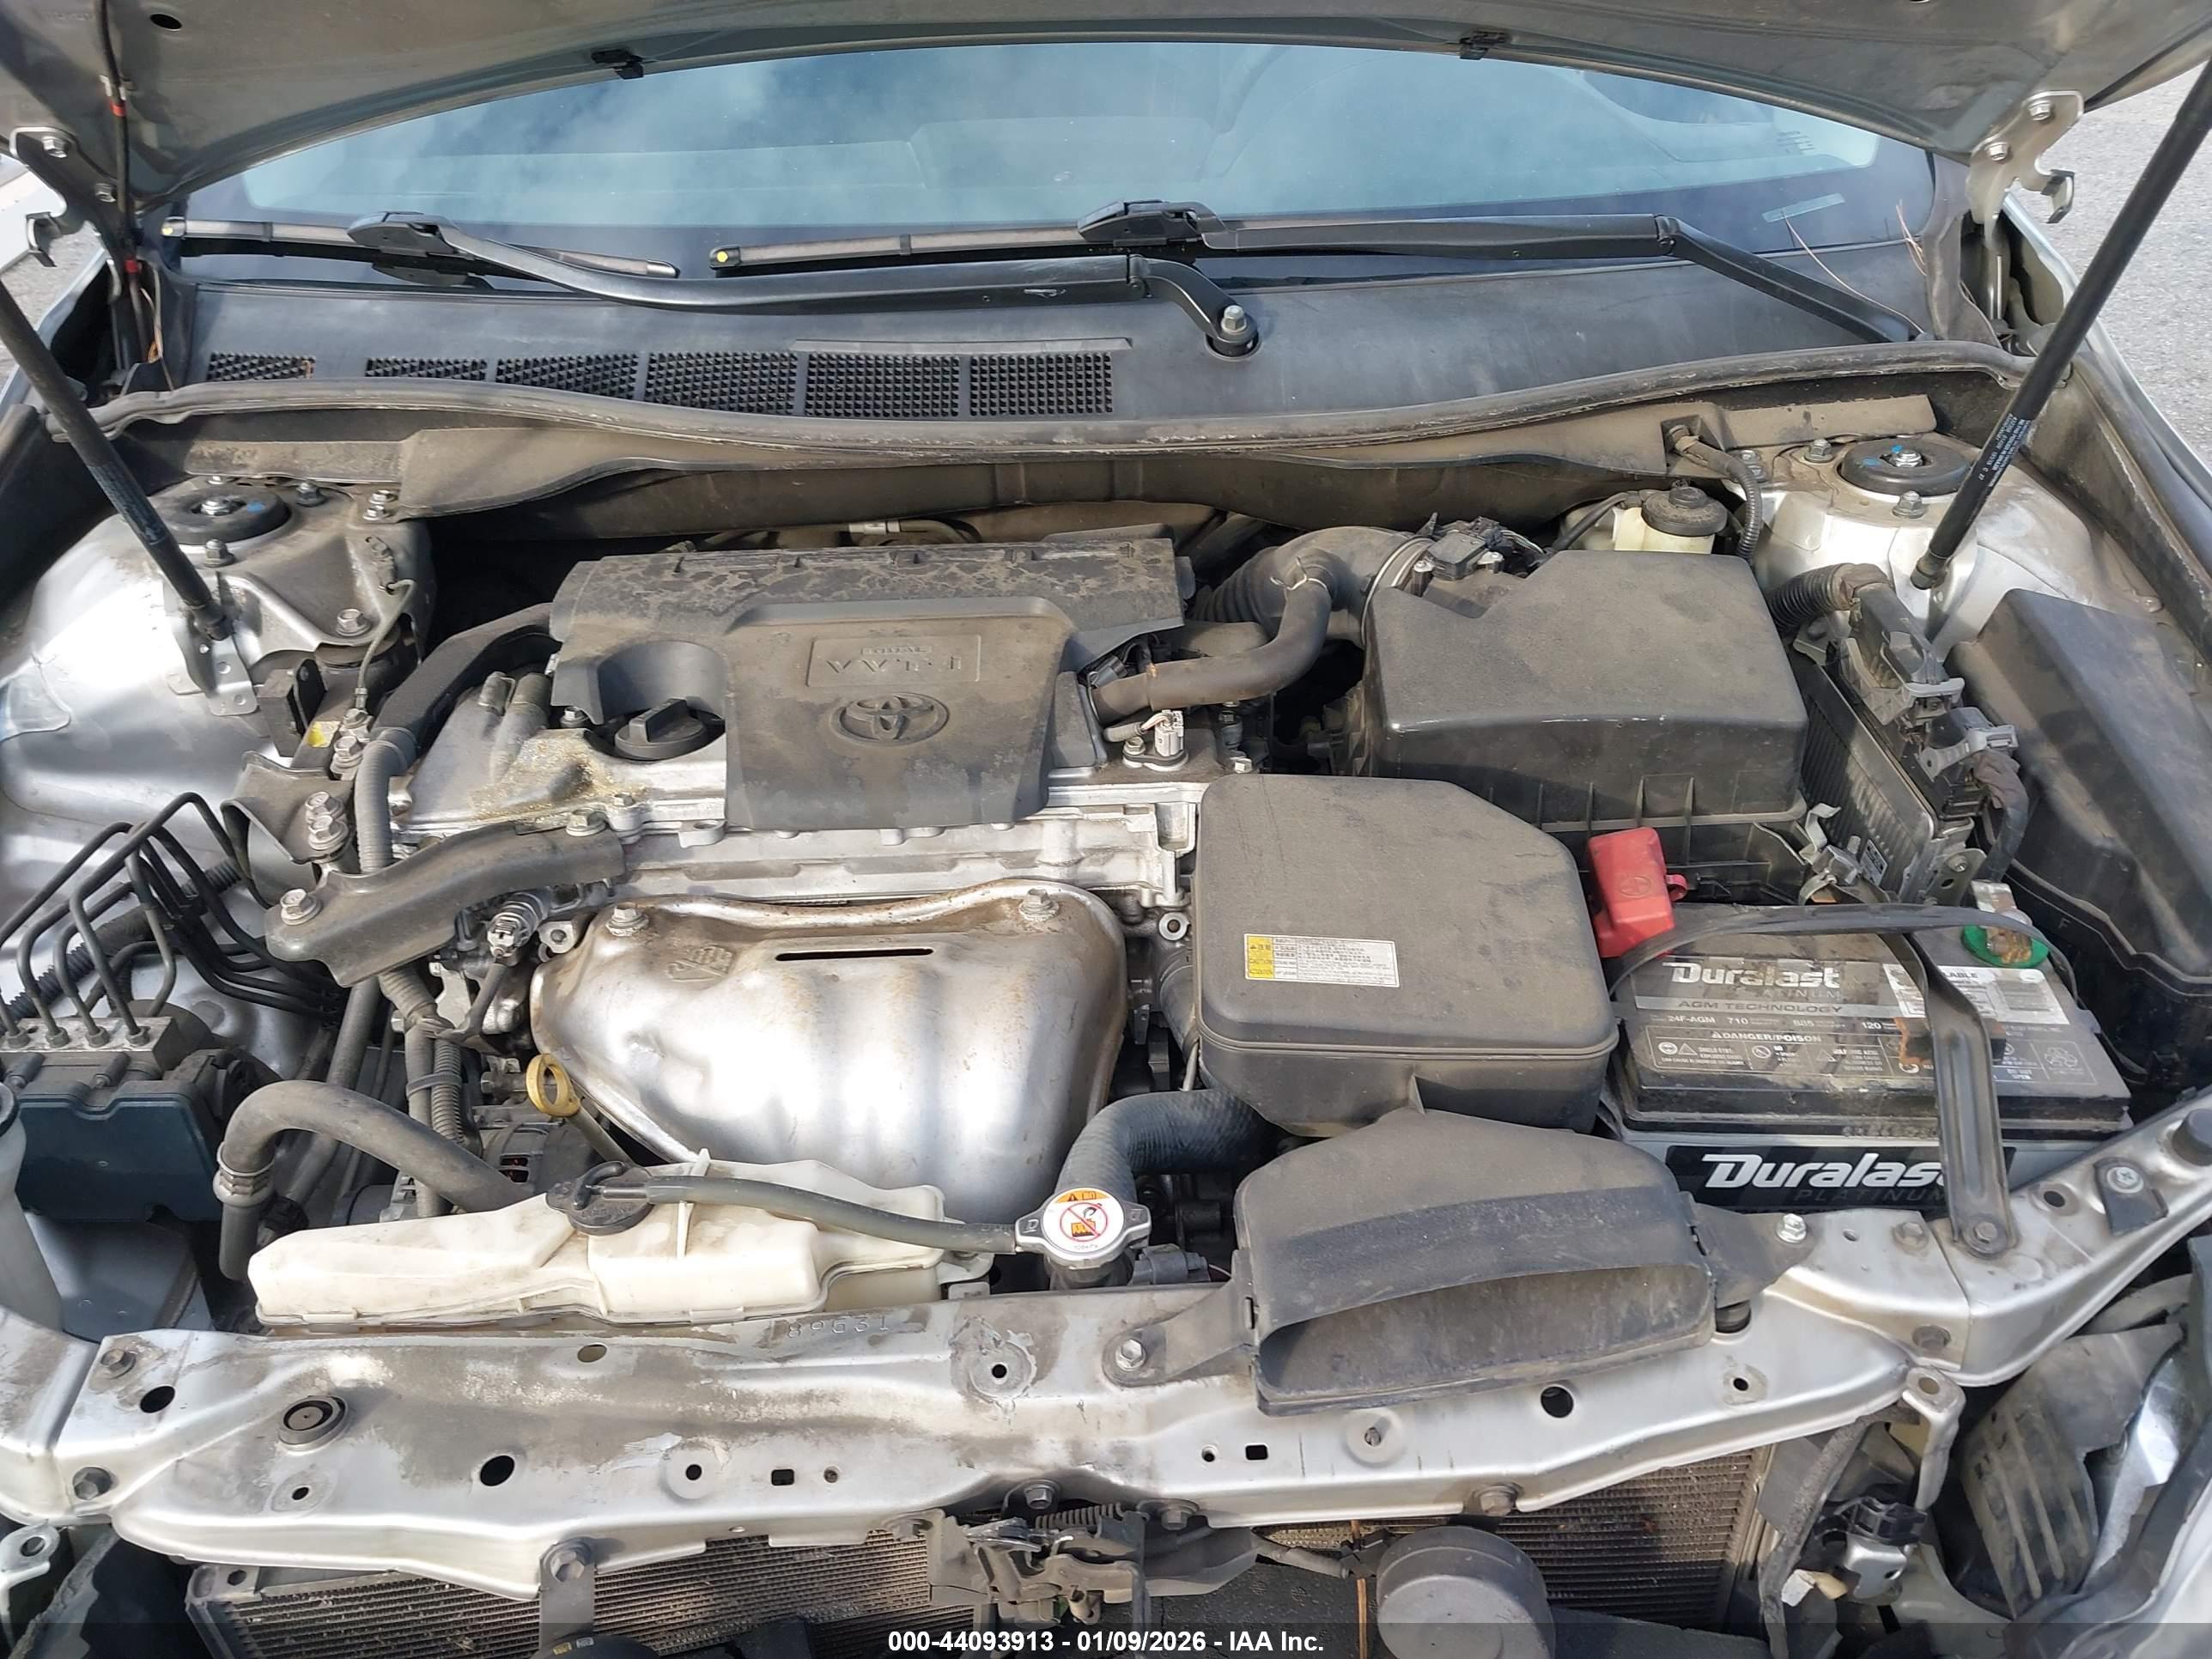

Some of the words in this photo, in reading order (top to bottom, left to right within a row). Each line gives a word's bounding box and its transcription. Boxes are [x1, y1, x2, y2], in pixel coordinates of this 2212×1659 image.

[1662, 962, 1840, 988] Duralast
[1678, 1000, 1718, 1009] AGM
[1724, 1002, 1844, 1013] TECHNOLOGY
[1667, 1015, 1716, 1024] 24F-AGM
[1726, 1017, 1748, 1025] 710
[1862, 1021, 1882, 1030] 120
[1722, 1032, 1821, 1042] DANGER/POISON
[1702, 1152, 1945, 1189] Duralas
